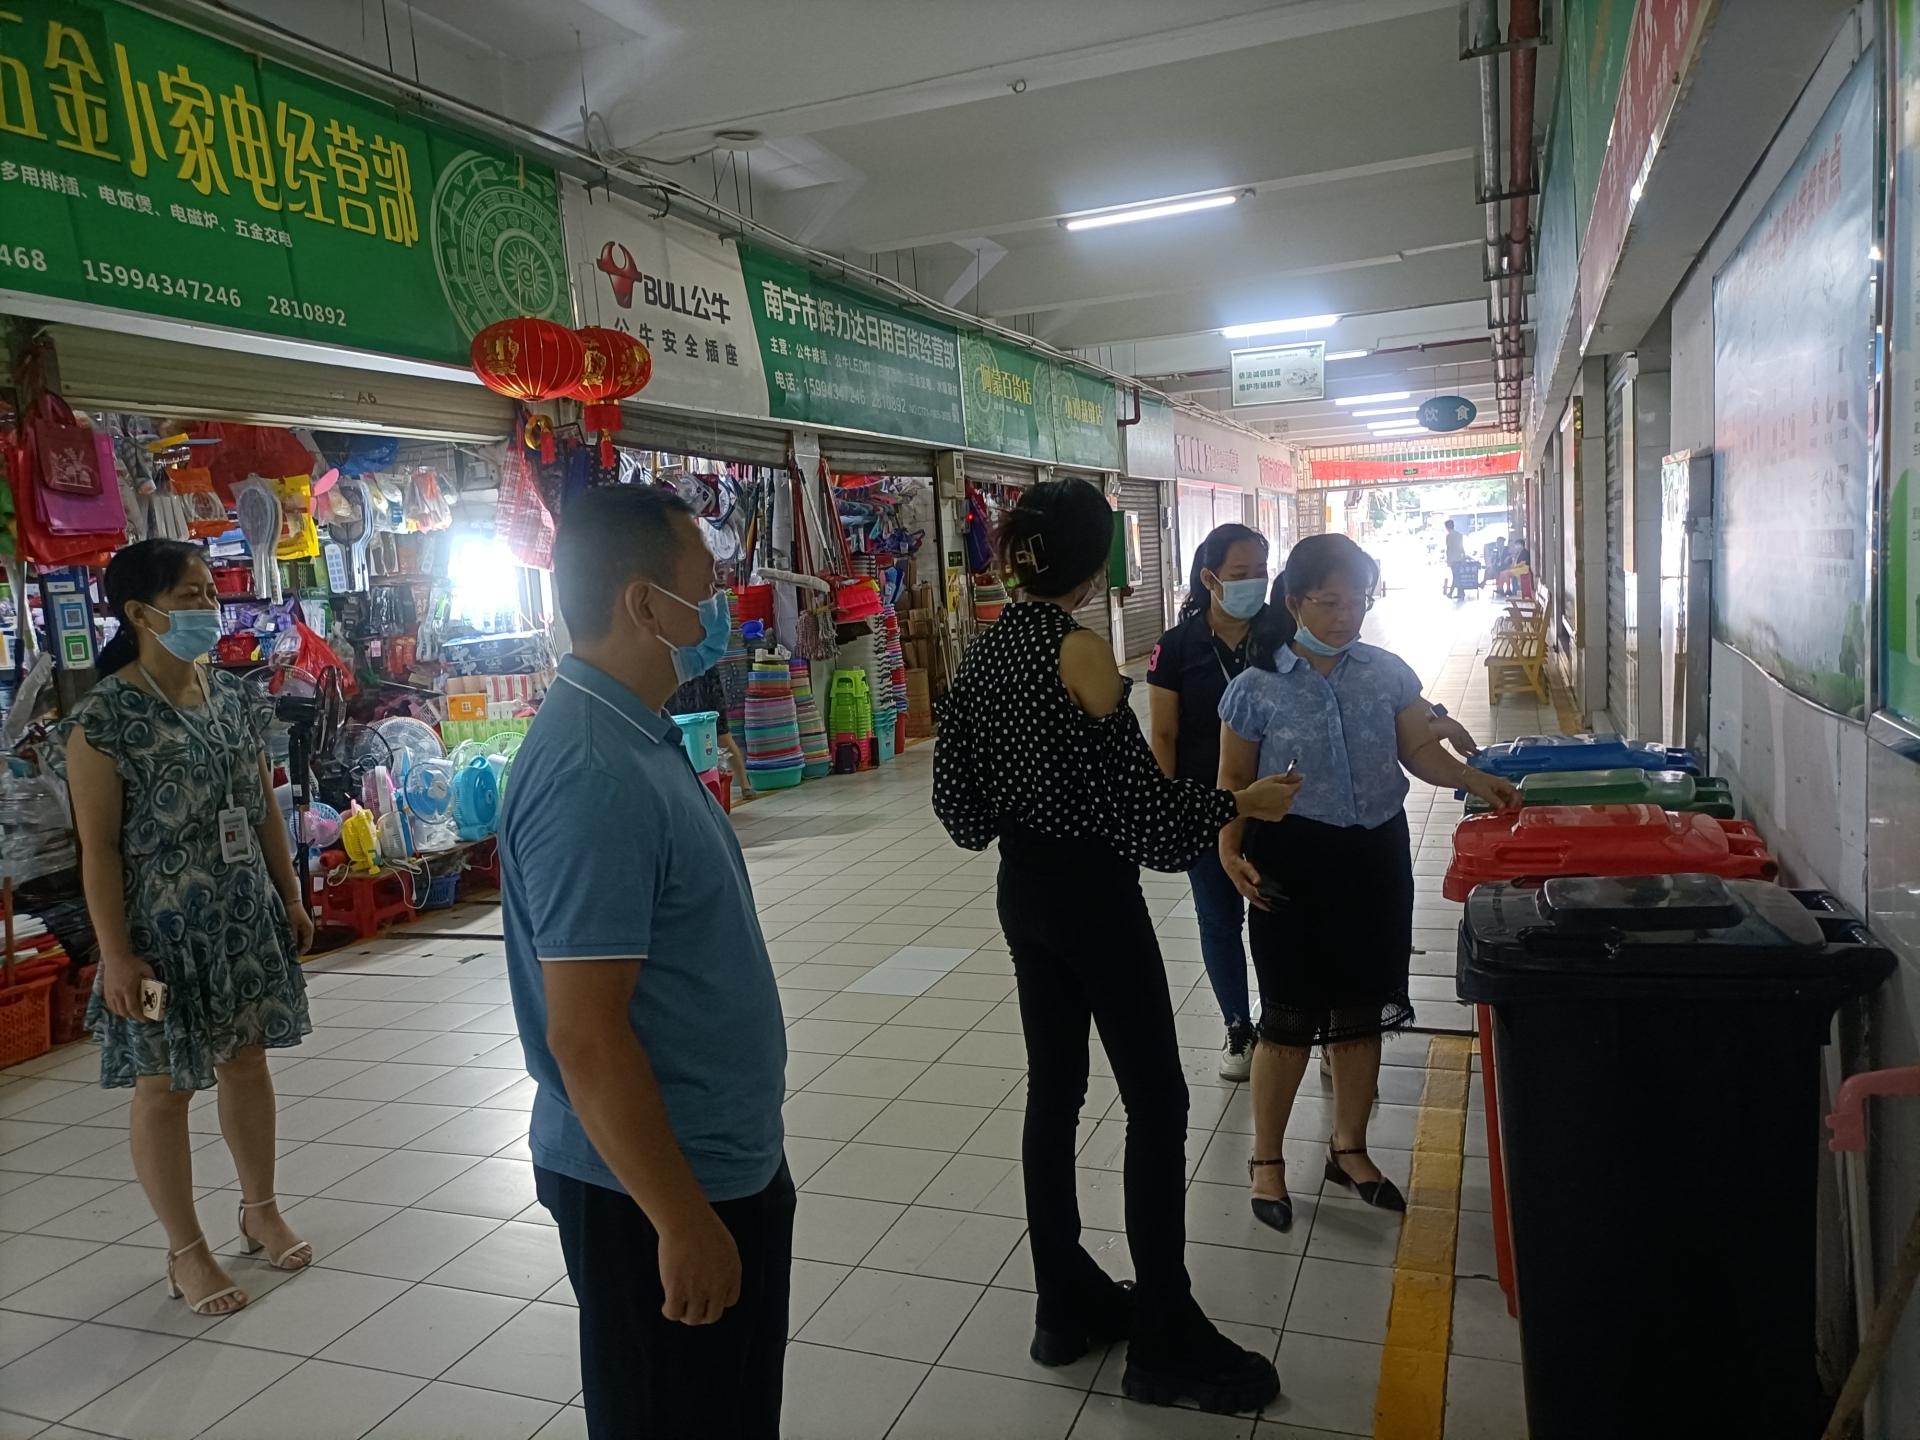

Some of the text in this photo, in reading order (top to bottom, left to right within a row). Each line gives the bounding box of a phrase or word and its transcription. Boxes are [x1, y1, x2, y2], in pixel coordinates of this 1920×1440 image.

[0, 11, 418, 248] 五金小家电经营部
[83, 259, 241, 308] 15994347246
[267, 295, 347, 327] 2810892
[761, 279, 956, 371] 南宁市辉力达日用百货经营部
[614, 316, 739, 367] 公牛安全插座
